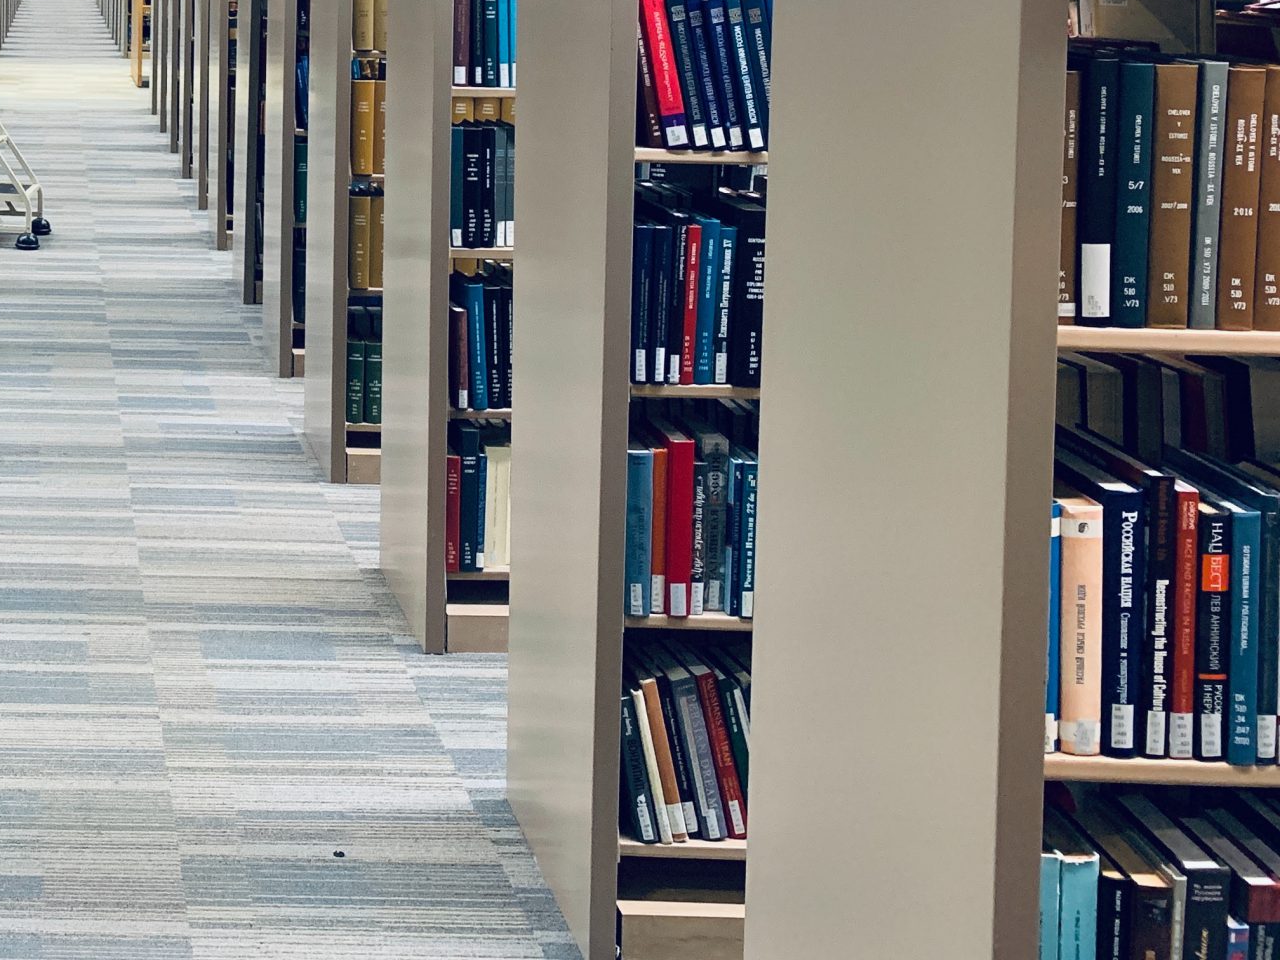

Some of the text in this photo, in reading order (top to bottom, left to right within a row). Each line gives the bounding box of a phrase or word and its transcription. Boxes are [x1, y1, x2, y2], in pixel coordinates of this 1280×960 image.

[1128, 180, 1145, 190] 5/7
[1127, 205, 1144, 214] 2006
[1233, 207, 1253, 216] 2016
[723, 239, 732, 248] XV
[1124, 275, 1136, 284] DK
[1124, 287, 1136, 296] 510
[1209, 522, 1223, 590] НАЦ БЕСТ
[1151, 579, 1169, 636] Reconstructing
[1209, 594, 1221, 671] ЛЕВ АННИНСКИЙ
[1154, 637, 1167, 649] the
[1154, 651, 1167, 674] House
[1154, 675, 1167, 683] of
[686, 694, 709, 754] PERSIAN
